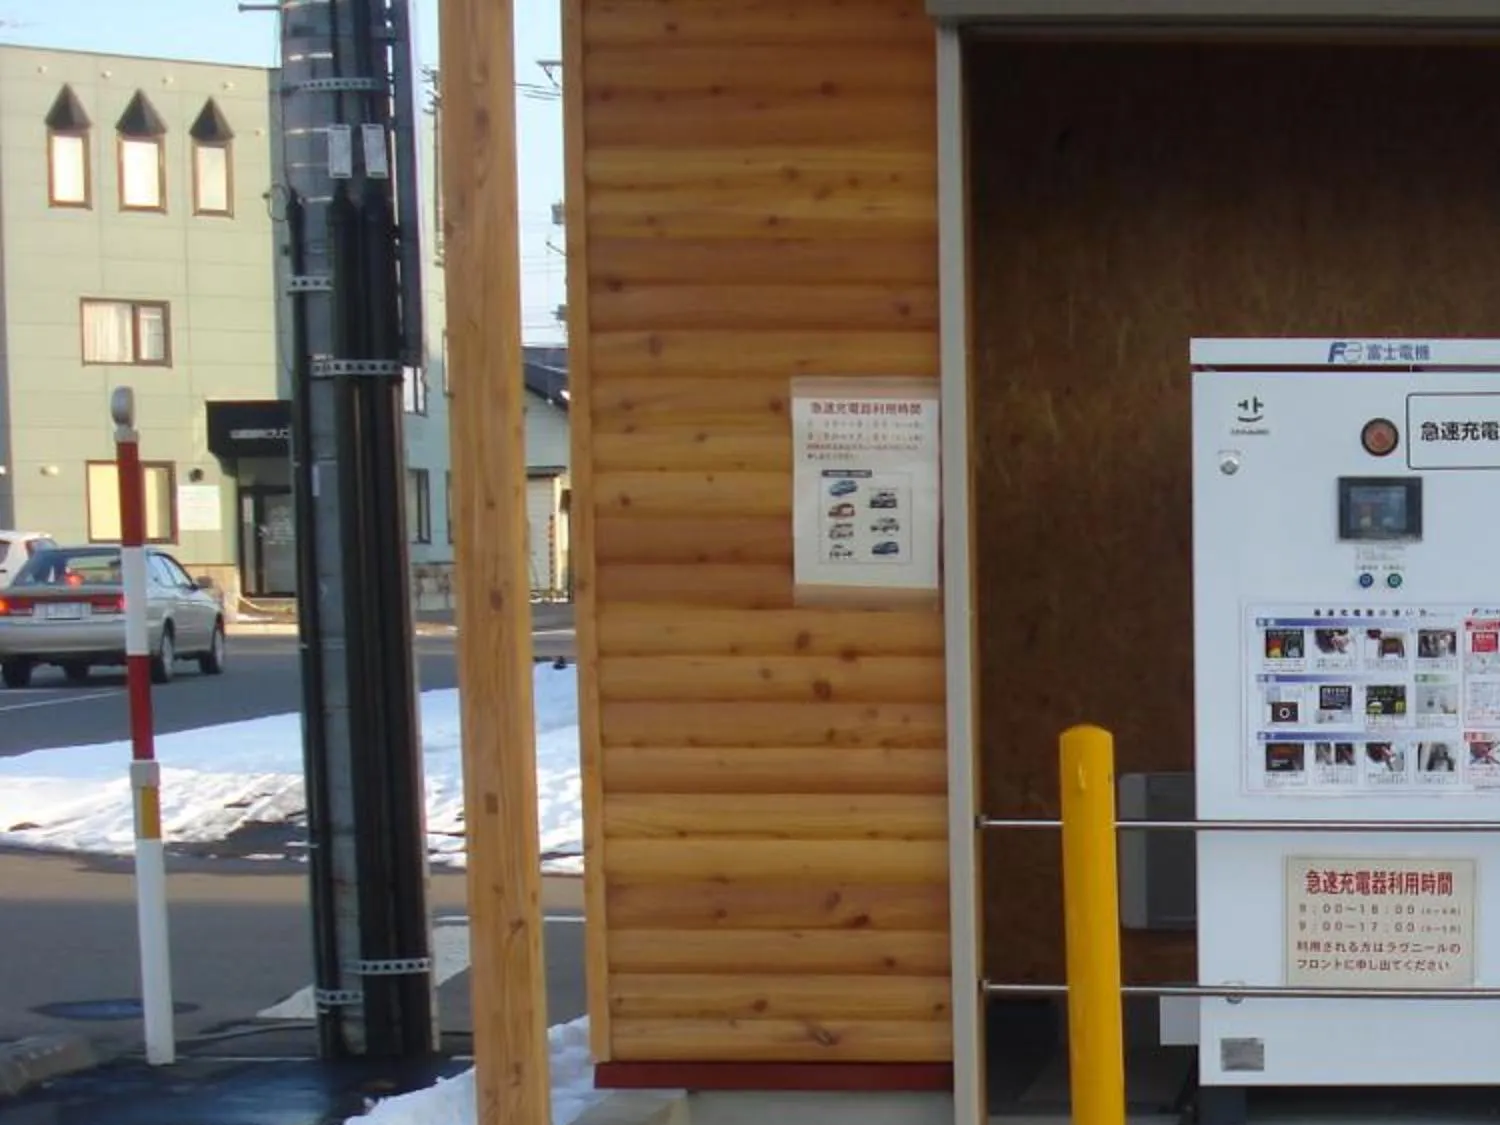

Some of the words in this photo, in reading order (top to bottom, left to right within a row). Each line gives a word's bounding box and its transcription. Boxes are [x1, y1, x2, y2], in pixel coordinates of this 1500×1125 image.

[1366, 343, 1431, 361] 富士電機
[1306, 869, 1453, 896] 急速充電器利用時間
[1297, 958, 1450, 972] フロントに申し出てください
